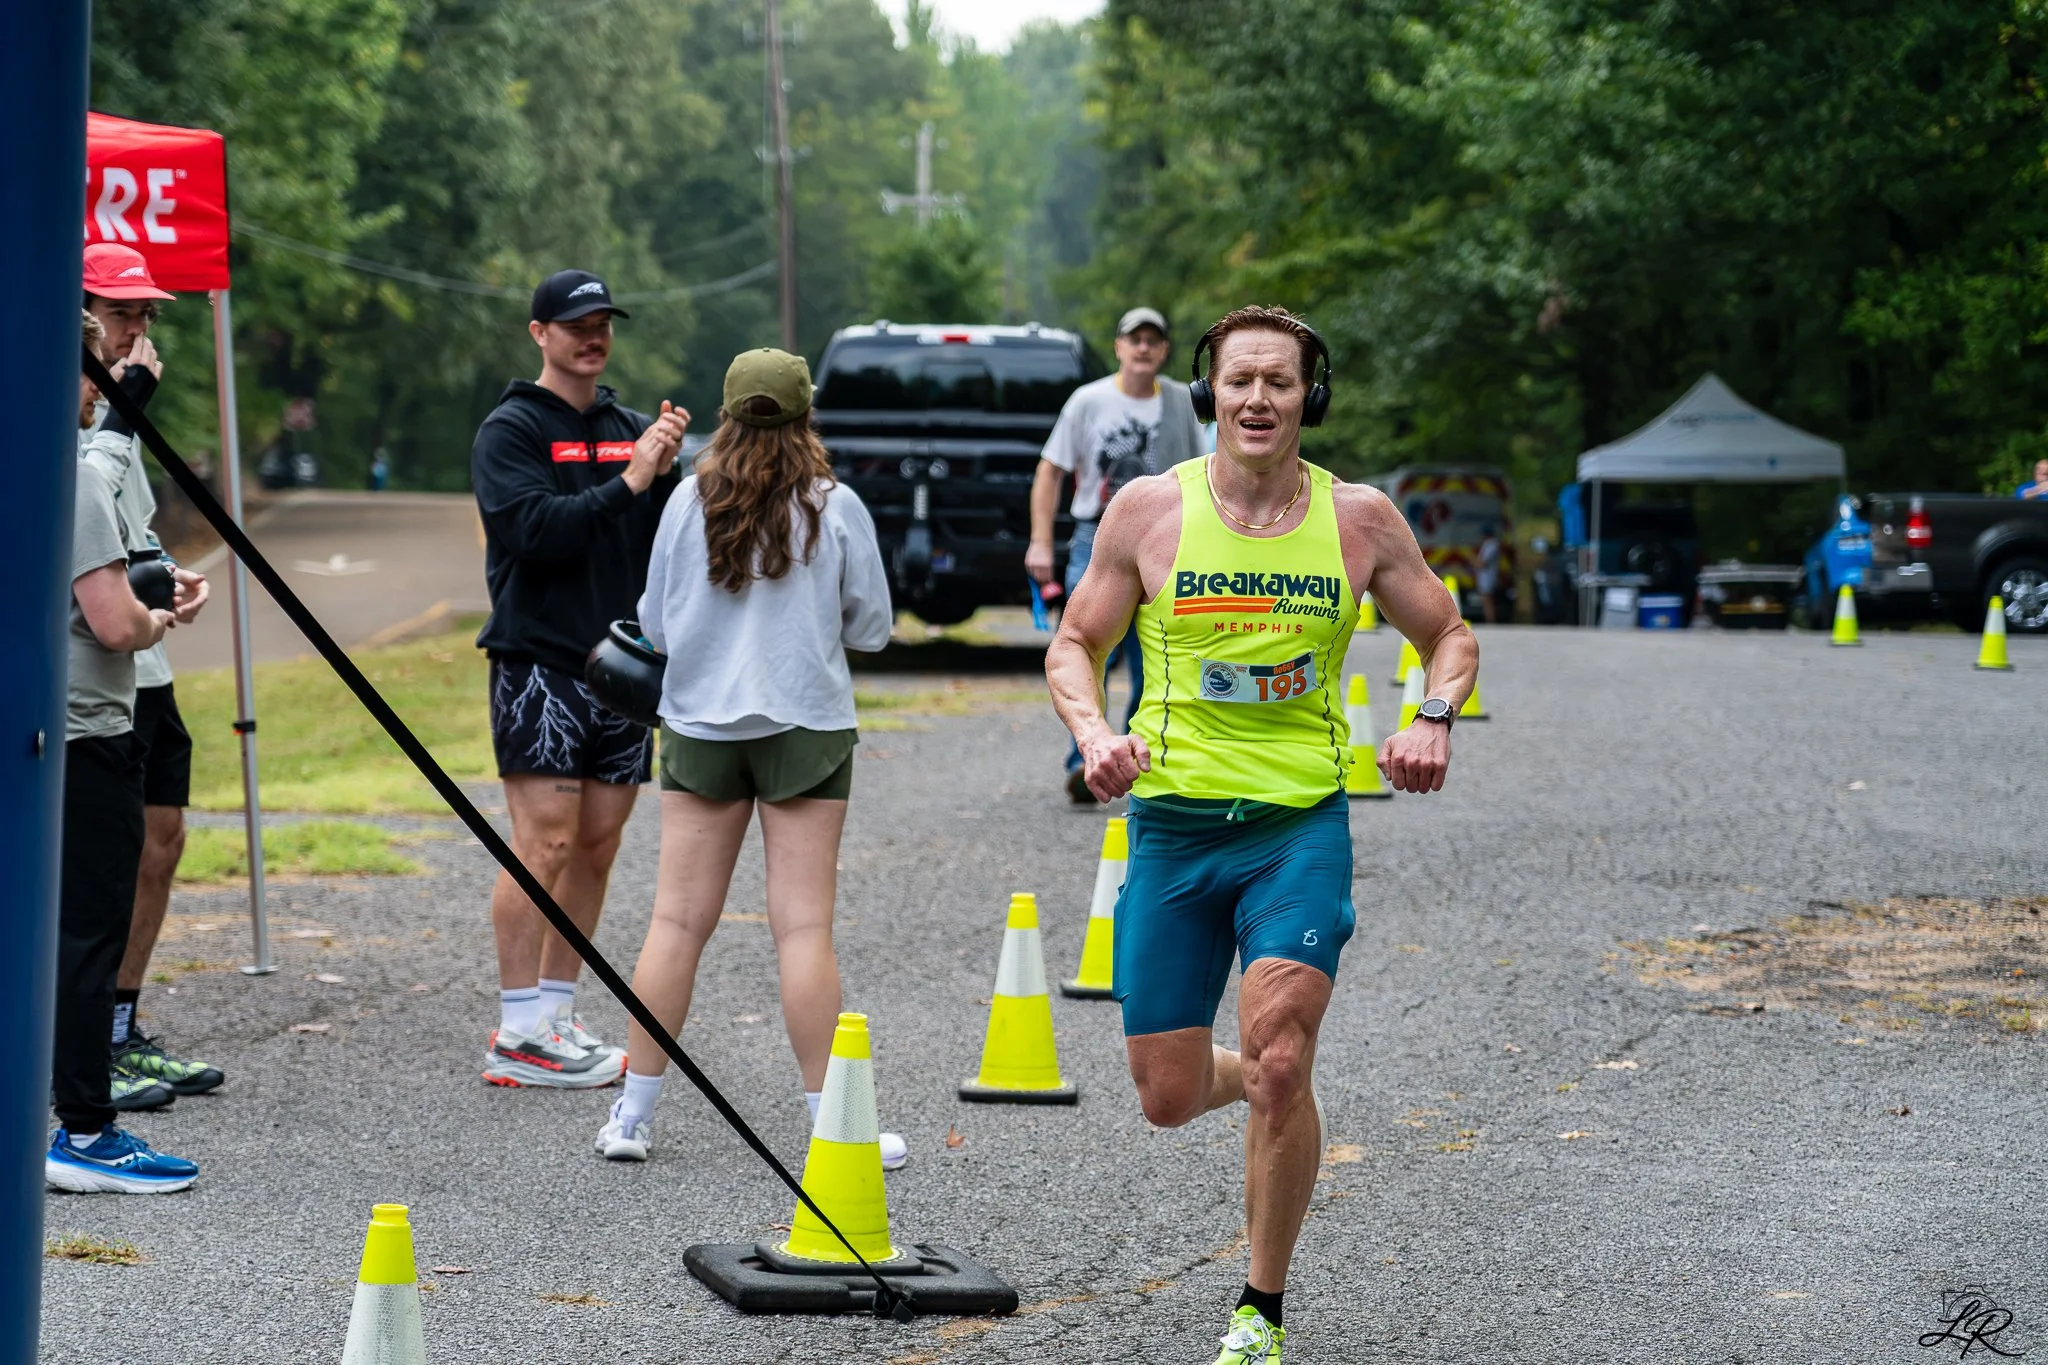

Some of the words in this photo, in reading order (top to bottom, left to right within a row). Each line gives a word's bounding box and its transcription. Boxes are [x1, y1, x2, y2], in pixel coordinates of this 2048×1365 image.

[86, 166, 178, 244] RE
[1174, 570, 1341, 608] Breakaway
[1213, 622, 1304, 634] MEMPHIS
[1272, 598, 1341, 625] Running
[1255, 667, 1308, 702] 195
